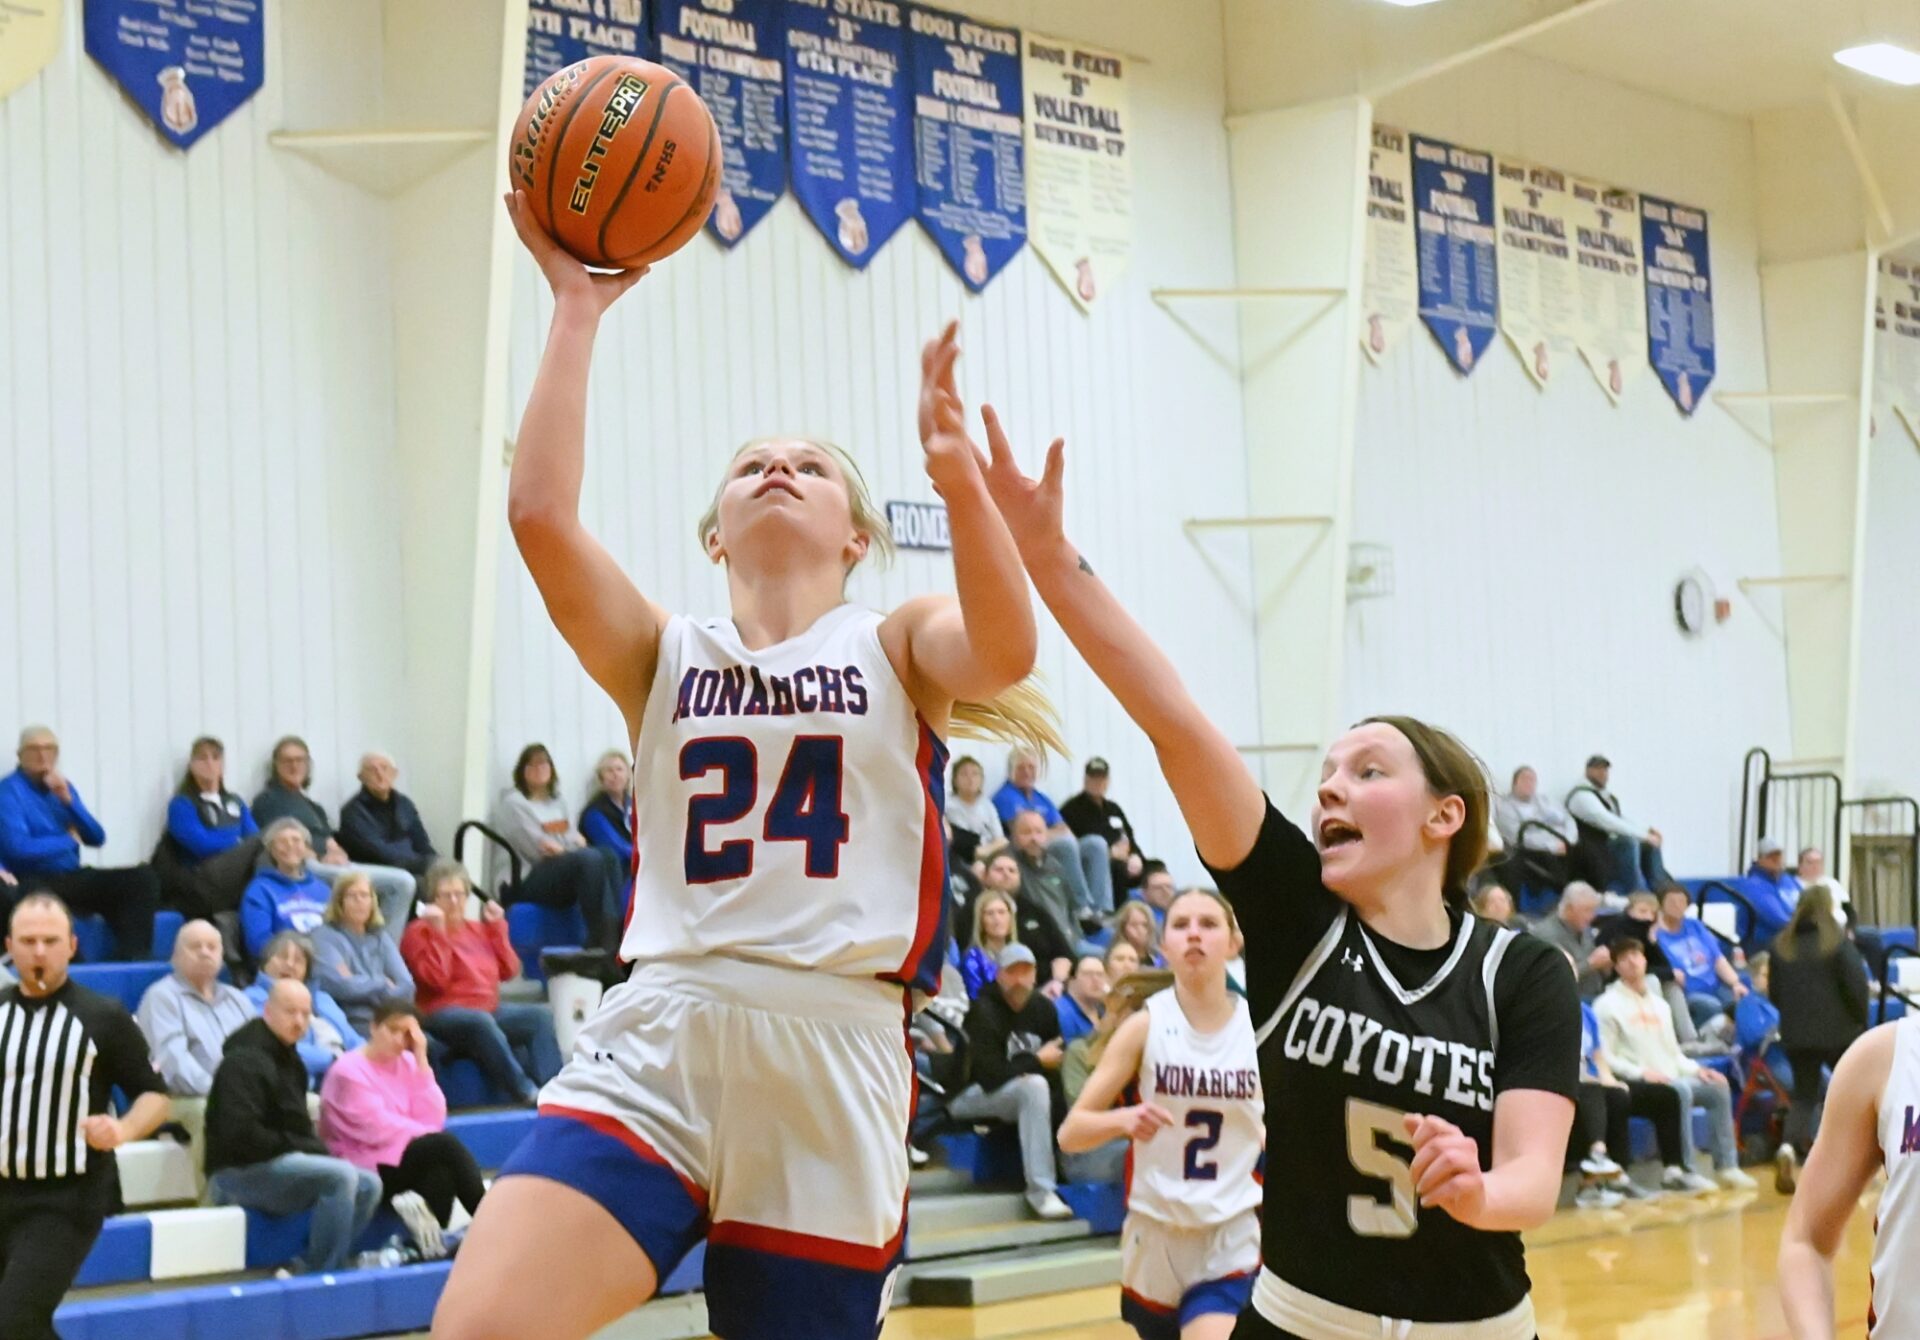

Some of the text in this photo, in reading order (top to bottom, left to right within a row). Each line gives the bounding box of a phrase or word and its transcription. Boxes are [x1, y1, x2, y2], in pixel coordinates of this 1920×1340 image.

[679, 5, 758, 51] FOOTBALL
[959, 22, 1018, 55] STATE
[932, 69, 1001, 110] FOOTBALL
[1033, 91, 1123, 135] VOLLEYBALL
[567, 74, 647, 217] ELITE PRO
[650, 138, 678, 184] NFHS
[679, 734, 850, 885] 24
[1283, 997, 1496, 1112] COYOTES
[1155, 1062, 1258, 1100] MONARCHS
[1184, 1108, 1224, 1182] 2
[1344, 1096, 1420, 1240] 5
